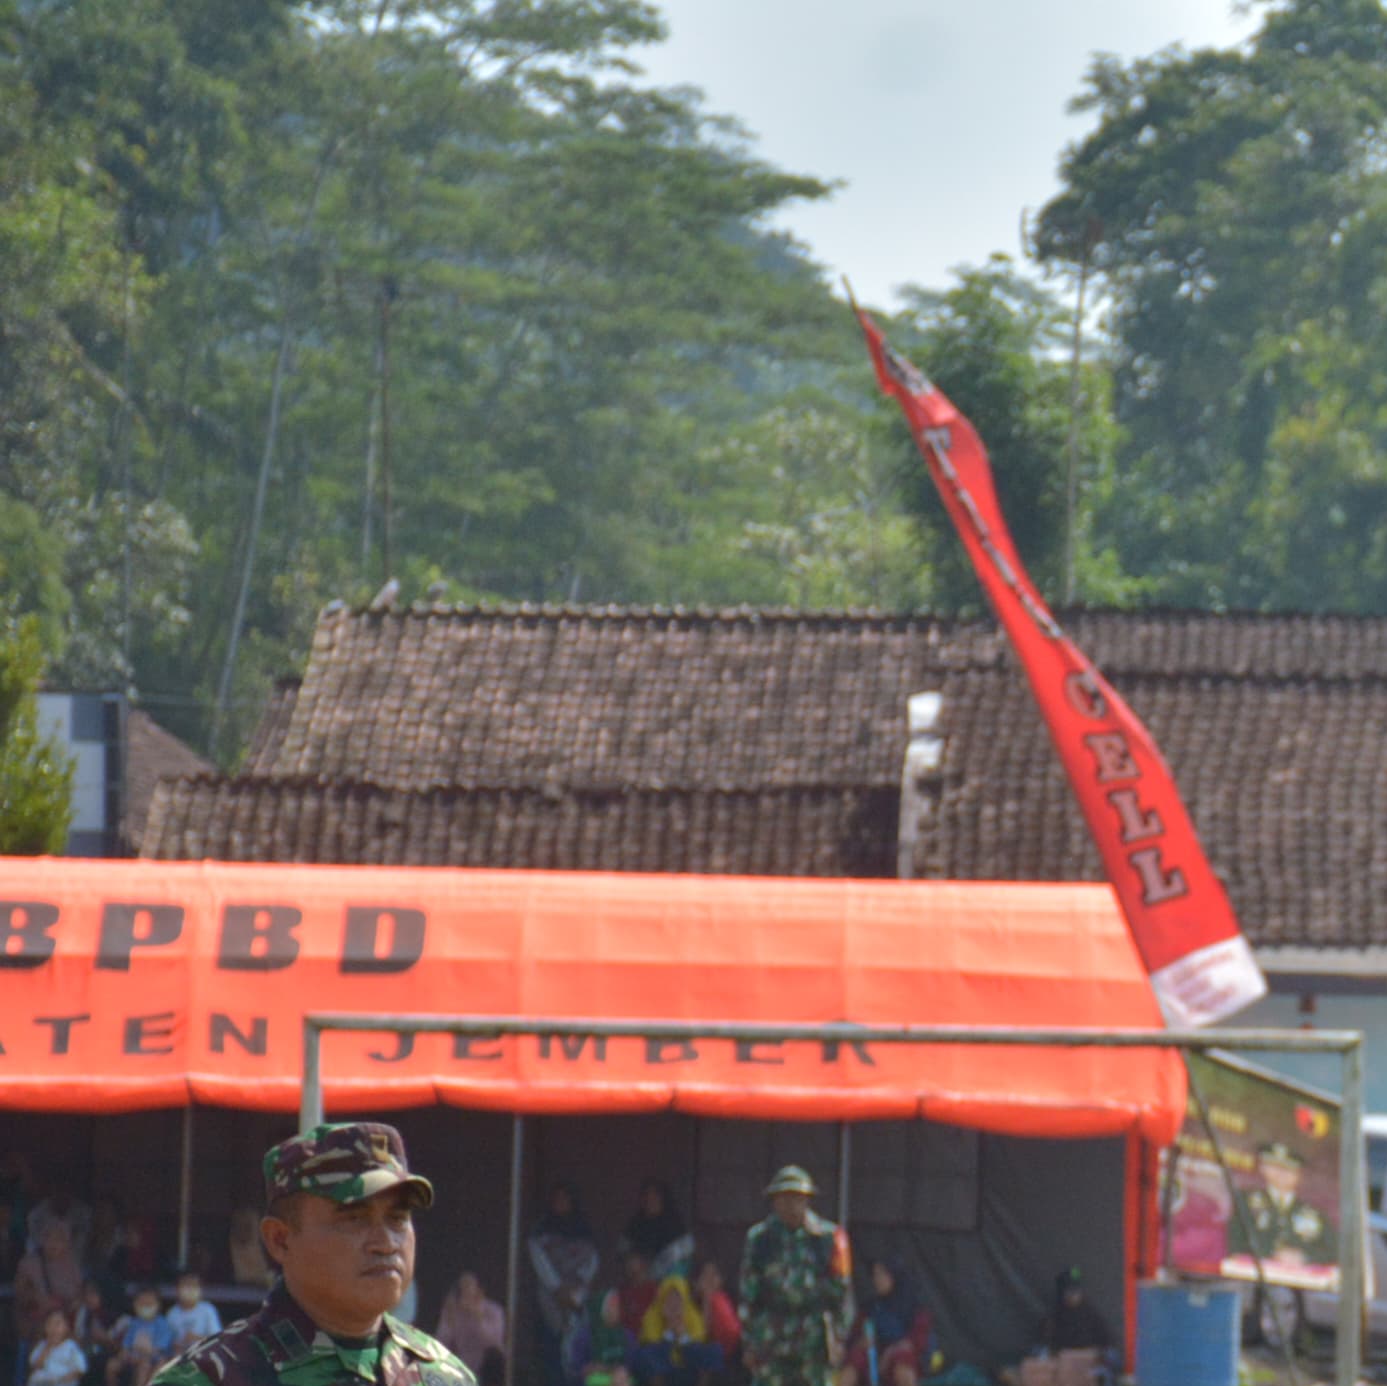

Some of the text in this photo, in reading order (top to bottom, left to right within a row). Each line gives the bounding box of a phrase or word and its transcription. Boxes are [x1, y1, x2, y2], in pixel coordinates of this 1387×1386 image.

[1063, 667, 1190, 906] CELL
[0, 901, 426, 975] BPBD
[0, 1011, 269, 1056] TEN
